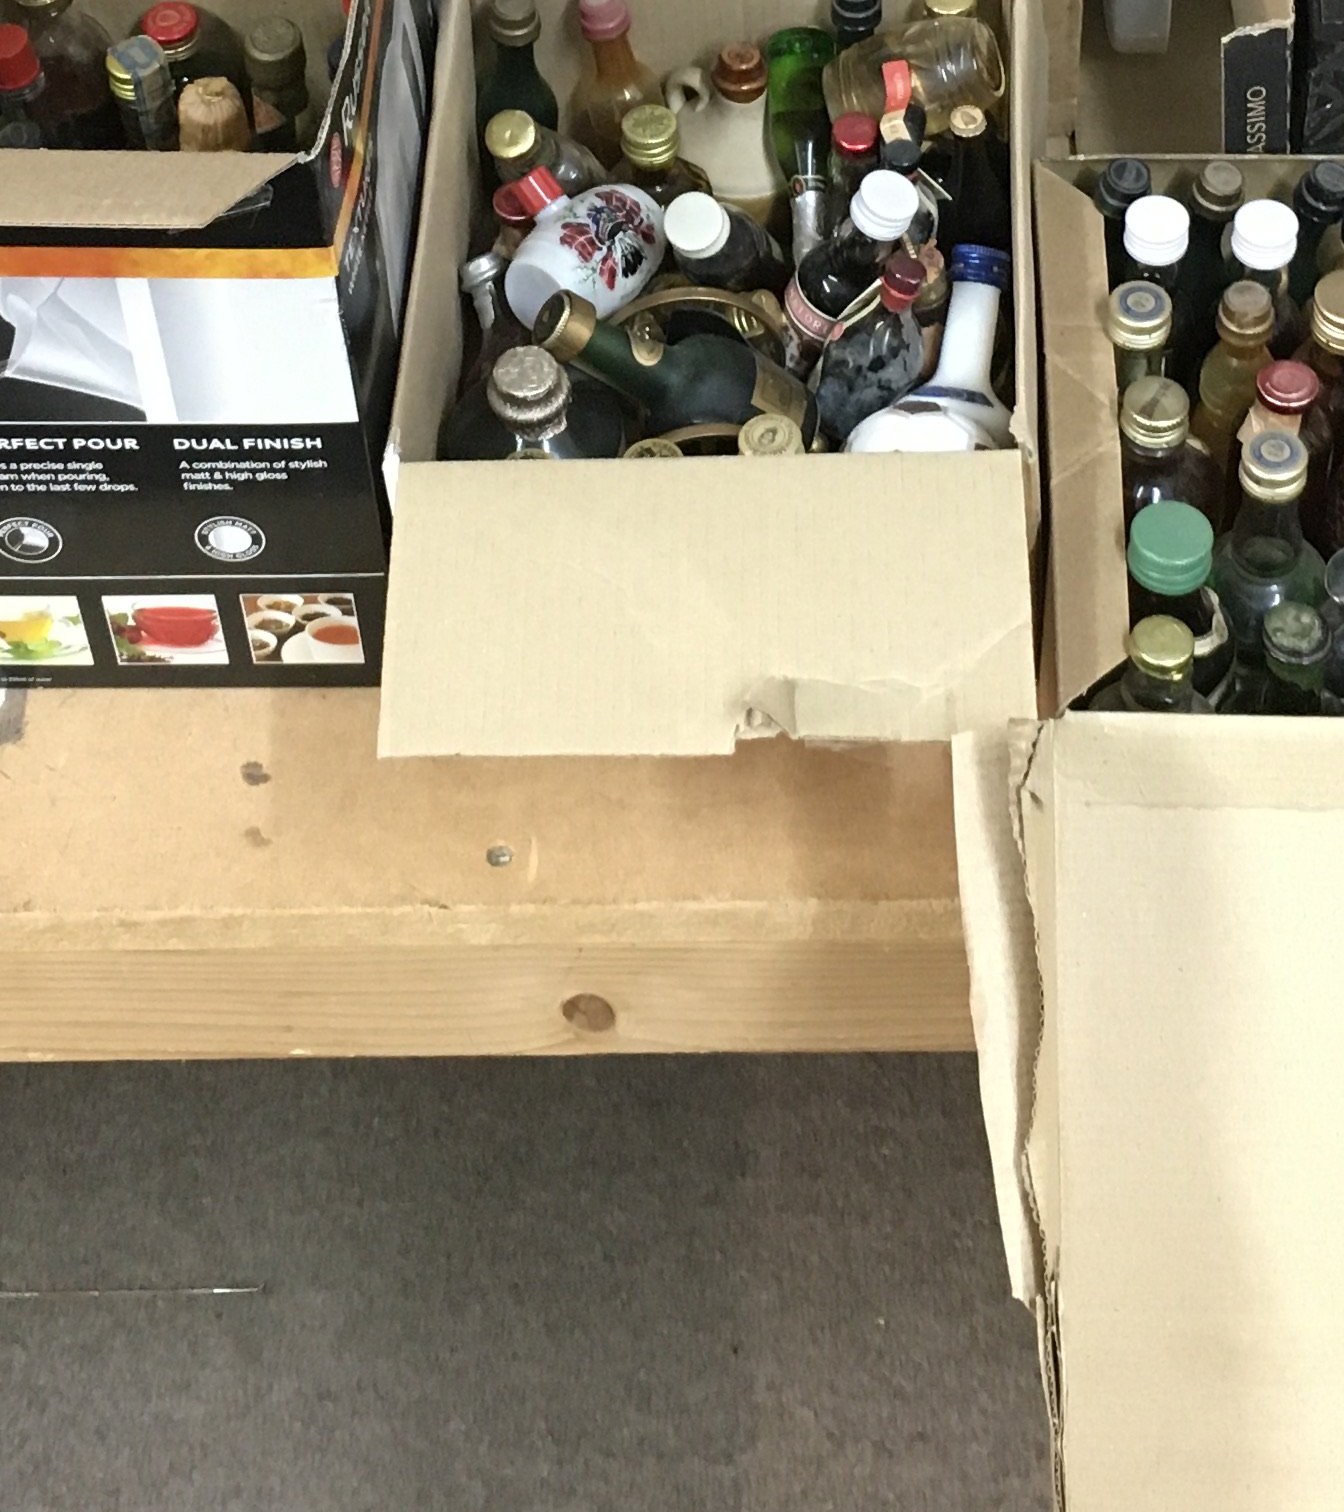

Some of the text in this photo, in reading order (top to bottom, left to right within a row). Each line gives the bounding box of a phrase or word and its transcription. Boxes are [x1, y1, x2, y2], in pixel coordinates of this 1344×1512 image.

[73, 438, 140, 450] POUR
[173, 437, 322, 450] DUAL FINISH
[20, 461, 64, 471] precise
[67, 461, 103, 471] single
[179, 459, 328, 470] A combination of stylish
[21, 472, 55, 480] when
[58, 472, 110, 482] pouring,
[181, 471, 288, 481] matt & high gloss
[11, 483, 23, 491] to
[26, 483, 46, 491] the
[50, 483, 71, 491] last
[74, 483, 96, 491] few
[99, 483, 138, 493] drops.
[183, 482, 234, 491] finishes.
